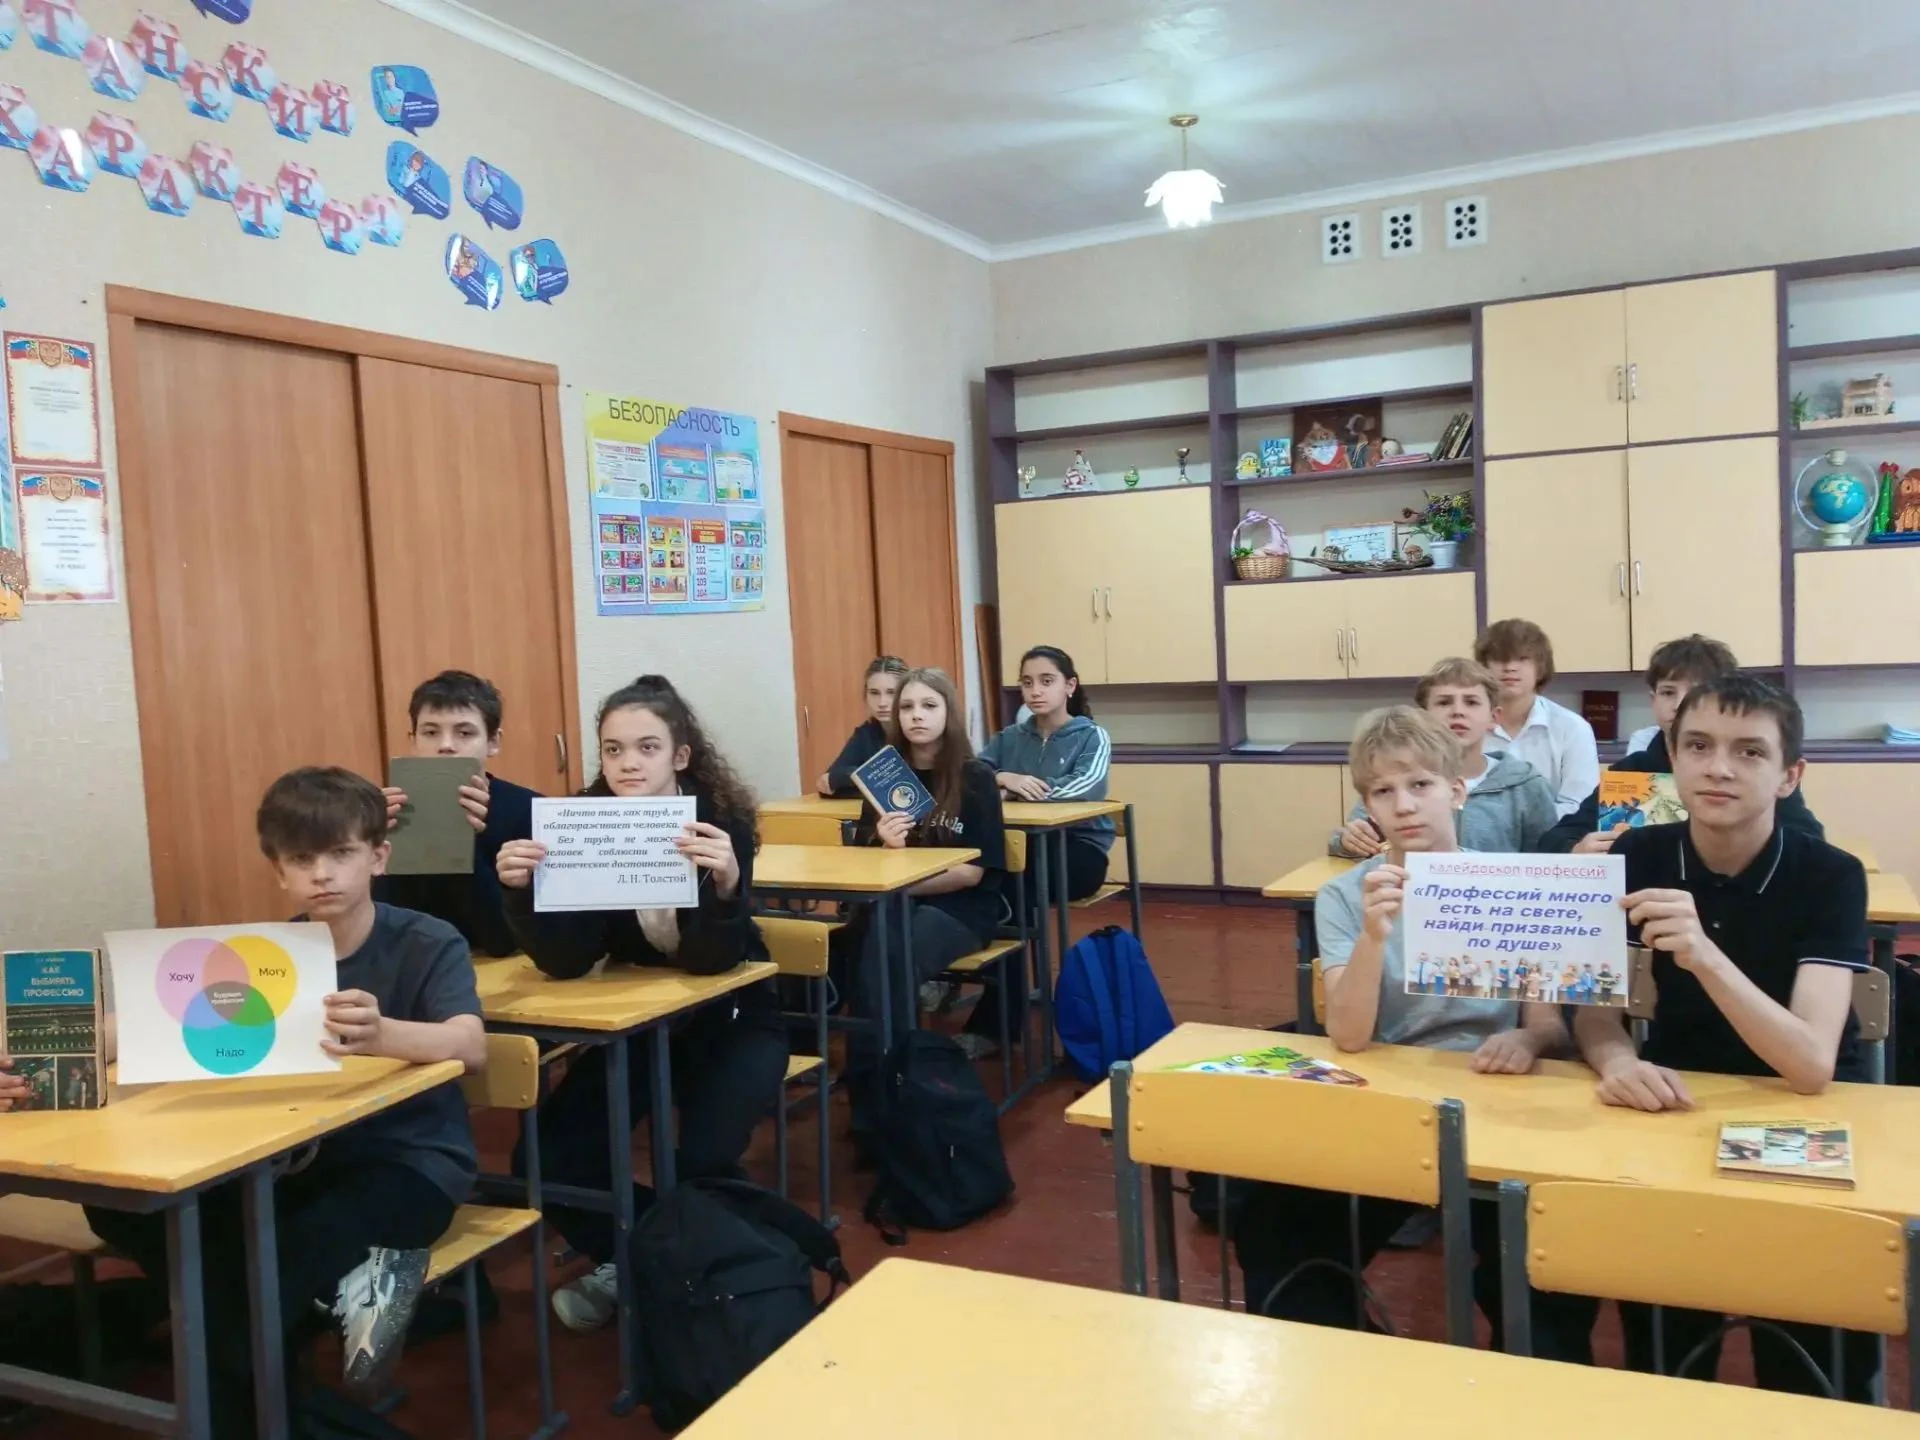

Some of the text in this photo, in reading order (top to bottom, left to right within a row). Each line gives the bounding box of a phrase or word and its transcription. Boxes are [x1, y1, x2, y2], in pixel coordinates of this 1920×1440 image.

[608, 398, 740, 437] БЕЗОПАСНОСТЬ
[557, 808, 684, 818] «Ничто так, как труд, не
[543, 821, 680, 832] облагораживает человека.
[557, 835, 575, 844] Без
[583, 834, 616, 846] труда
[624, 836, 636, 844] не
[598, 848, 648, 857] соблюсти
[544, 859, 684, 869] человеческое достоинство»
[1525, 864, 1607, 879] профессий
[617, 873, 687, 884] Л. Н. Толстой
[1413, 884, 1614, 904] «Профессий много
[1439, 903, 1584, 922] есть на свете,
[1423, 917, 1603, 937] найди призванье
[1466, 937, 1563, 953] по душе»
[168, 972, 195, 982] Хочу
[258, 967, 287, 978] Могу
[215, 1048, 245, 1058] Надо
